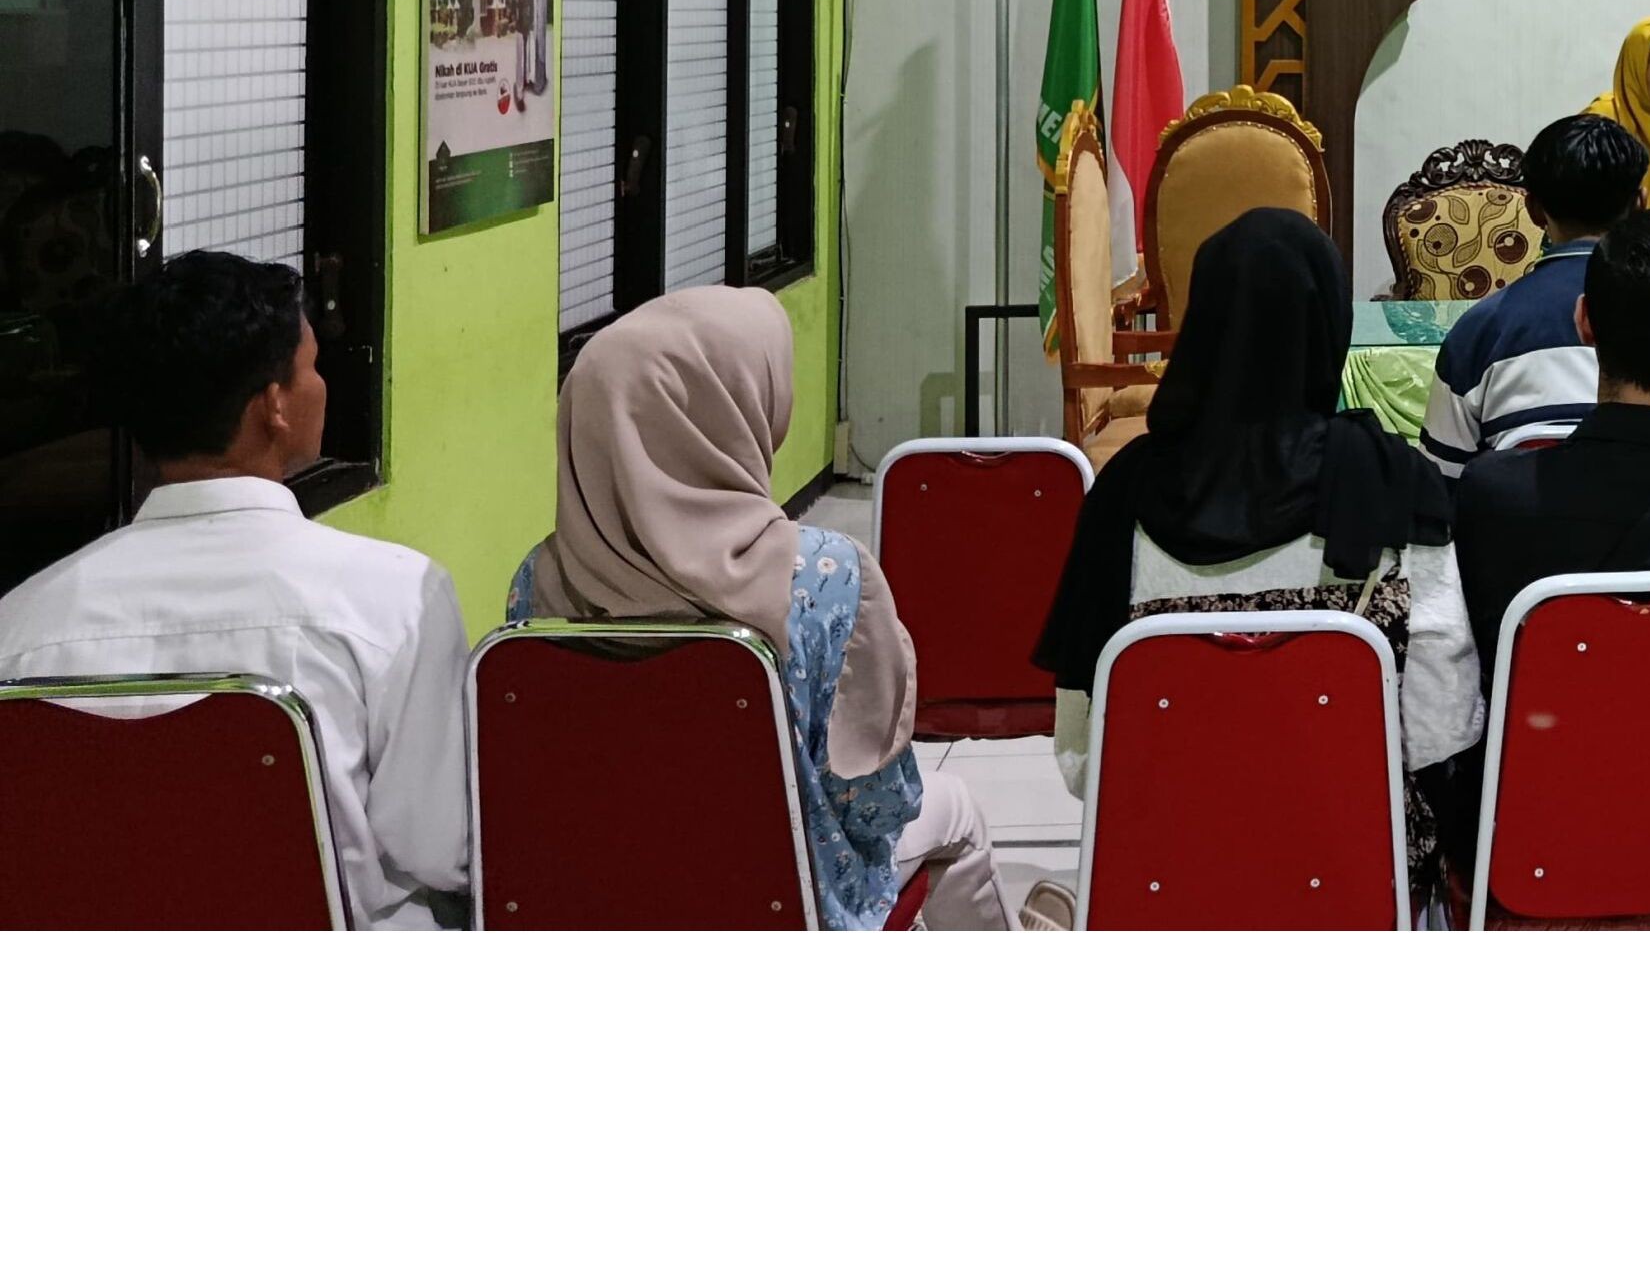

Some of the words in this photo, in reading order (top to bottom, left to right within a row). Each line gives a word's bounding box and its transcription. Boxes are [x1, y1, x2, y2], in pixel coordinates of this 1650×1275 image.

[435, 63, 454, 77] Nikah
[456, 62, 462, 75] di
[464, 61, 478, 75] KUA
[479, 61, 497, 73] Gratis
